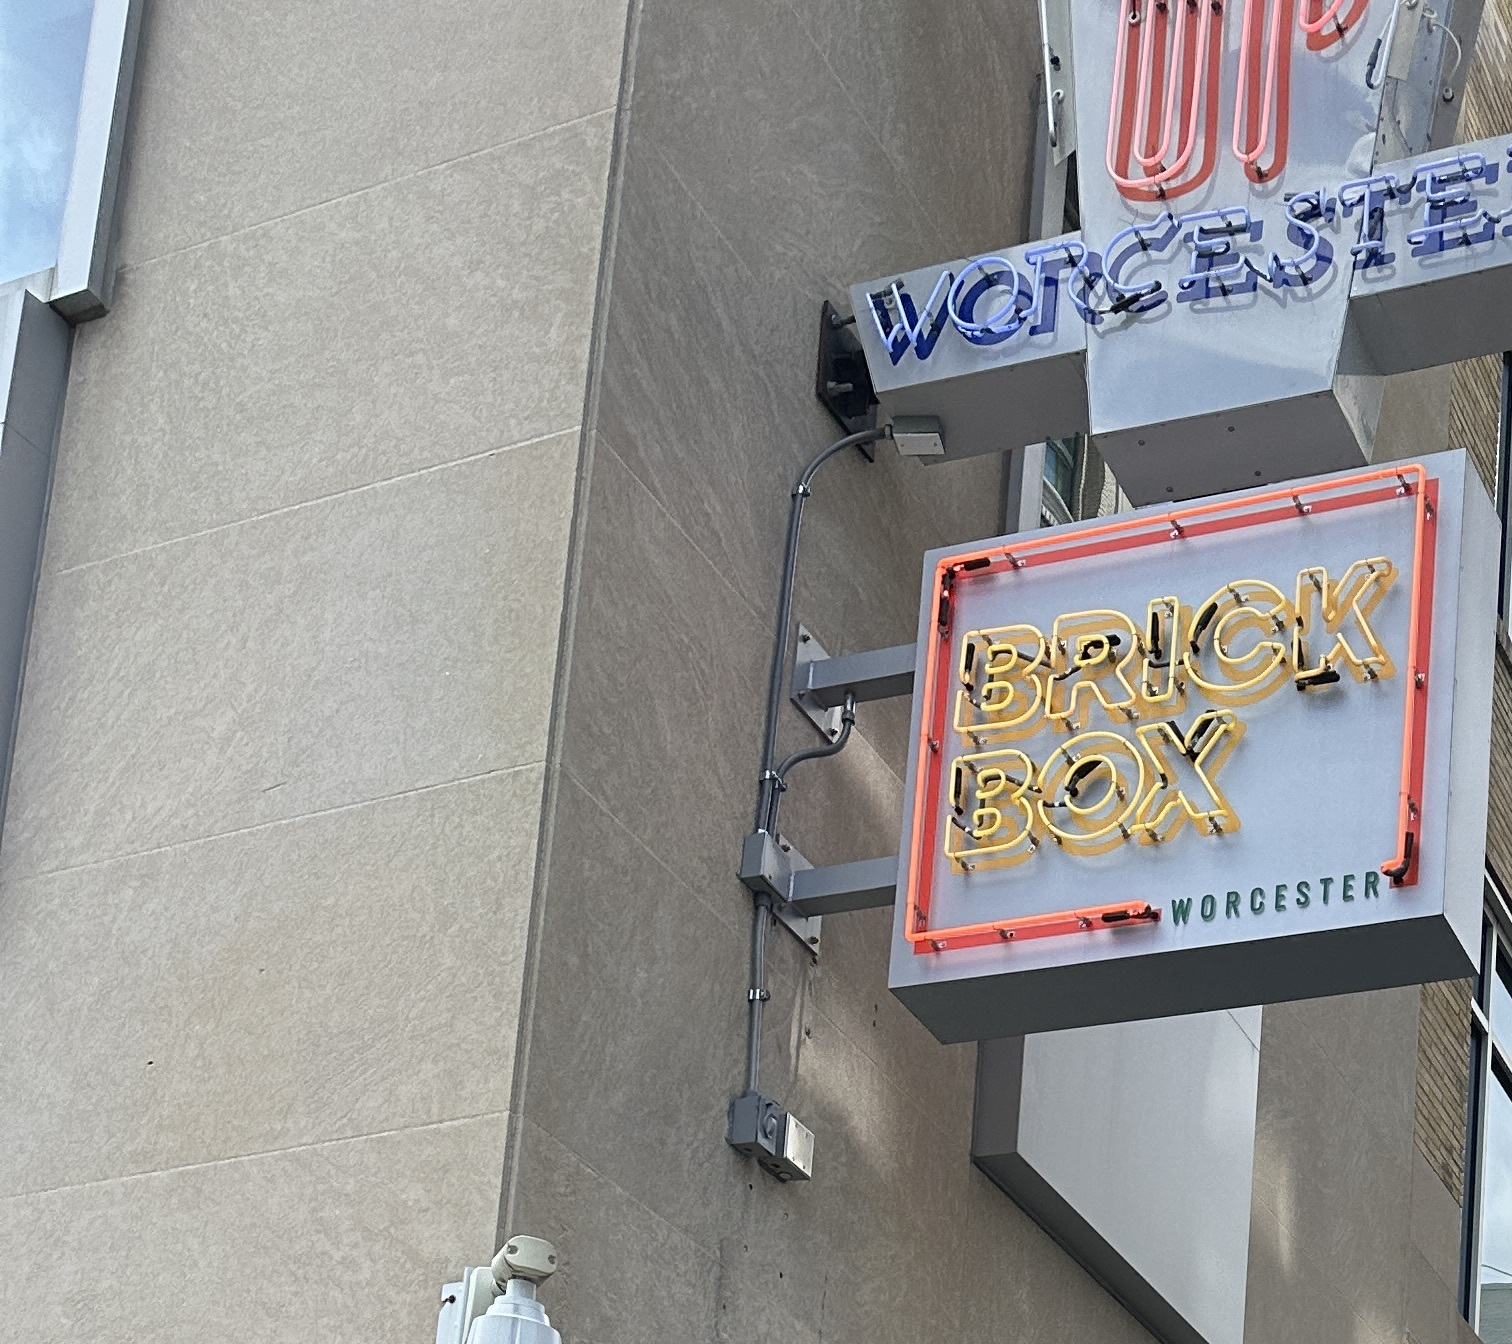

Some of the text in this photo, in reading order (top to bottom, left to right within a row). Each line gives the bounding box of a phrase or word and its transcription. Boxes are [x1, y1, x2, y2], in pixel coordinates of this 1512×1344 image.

[954, 556, 1398, 747] BRICK
[944, 710, 1245, 873] BOX
[1171, 871, 1380, 925] WORCESTER
